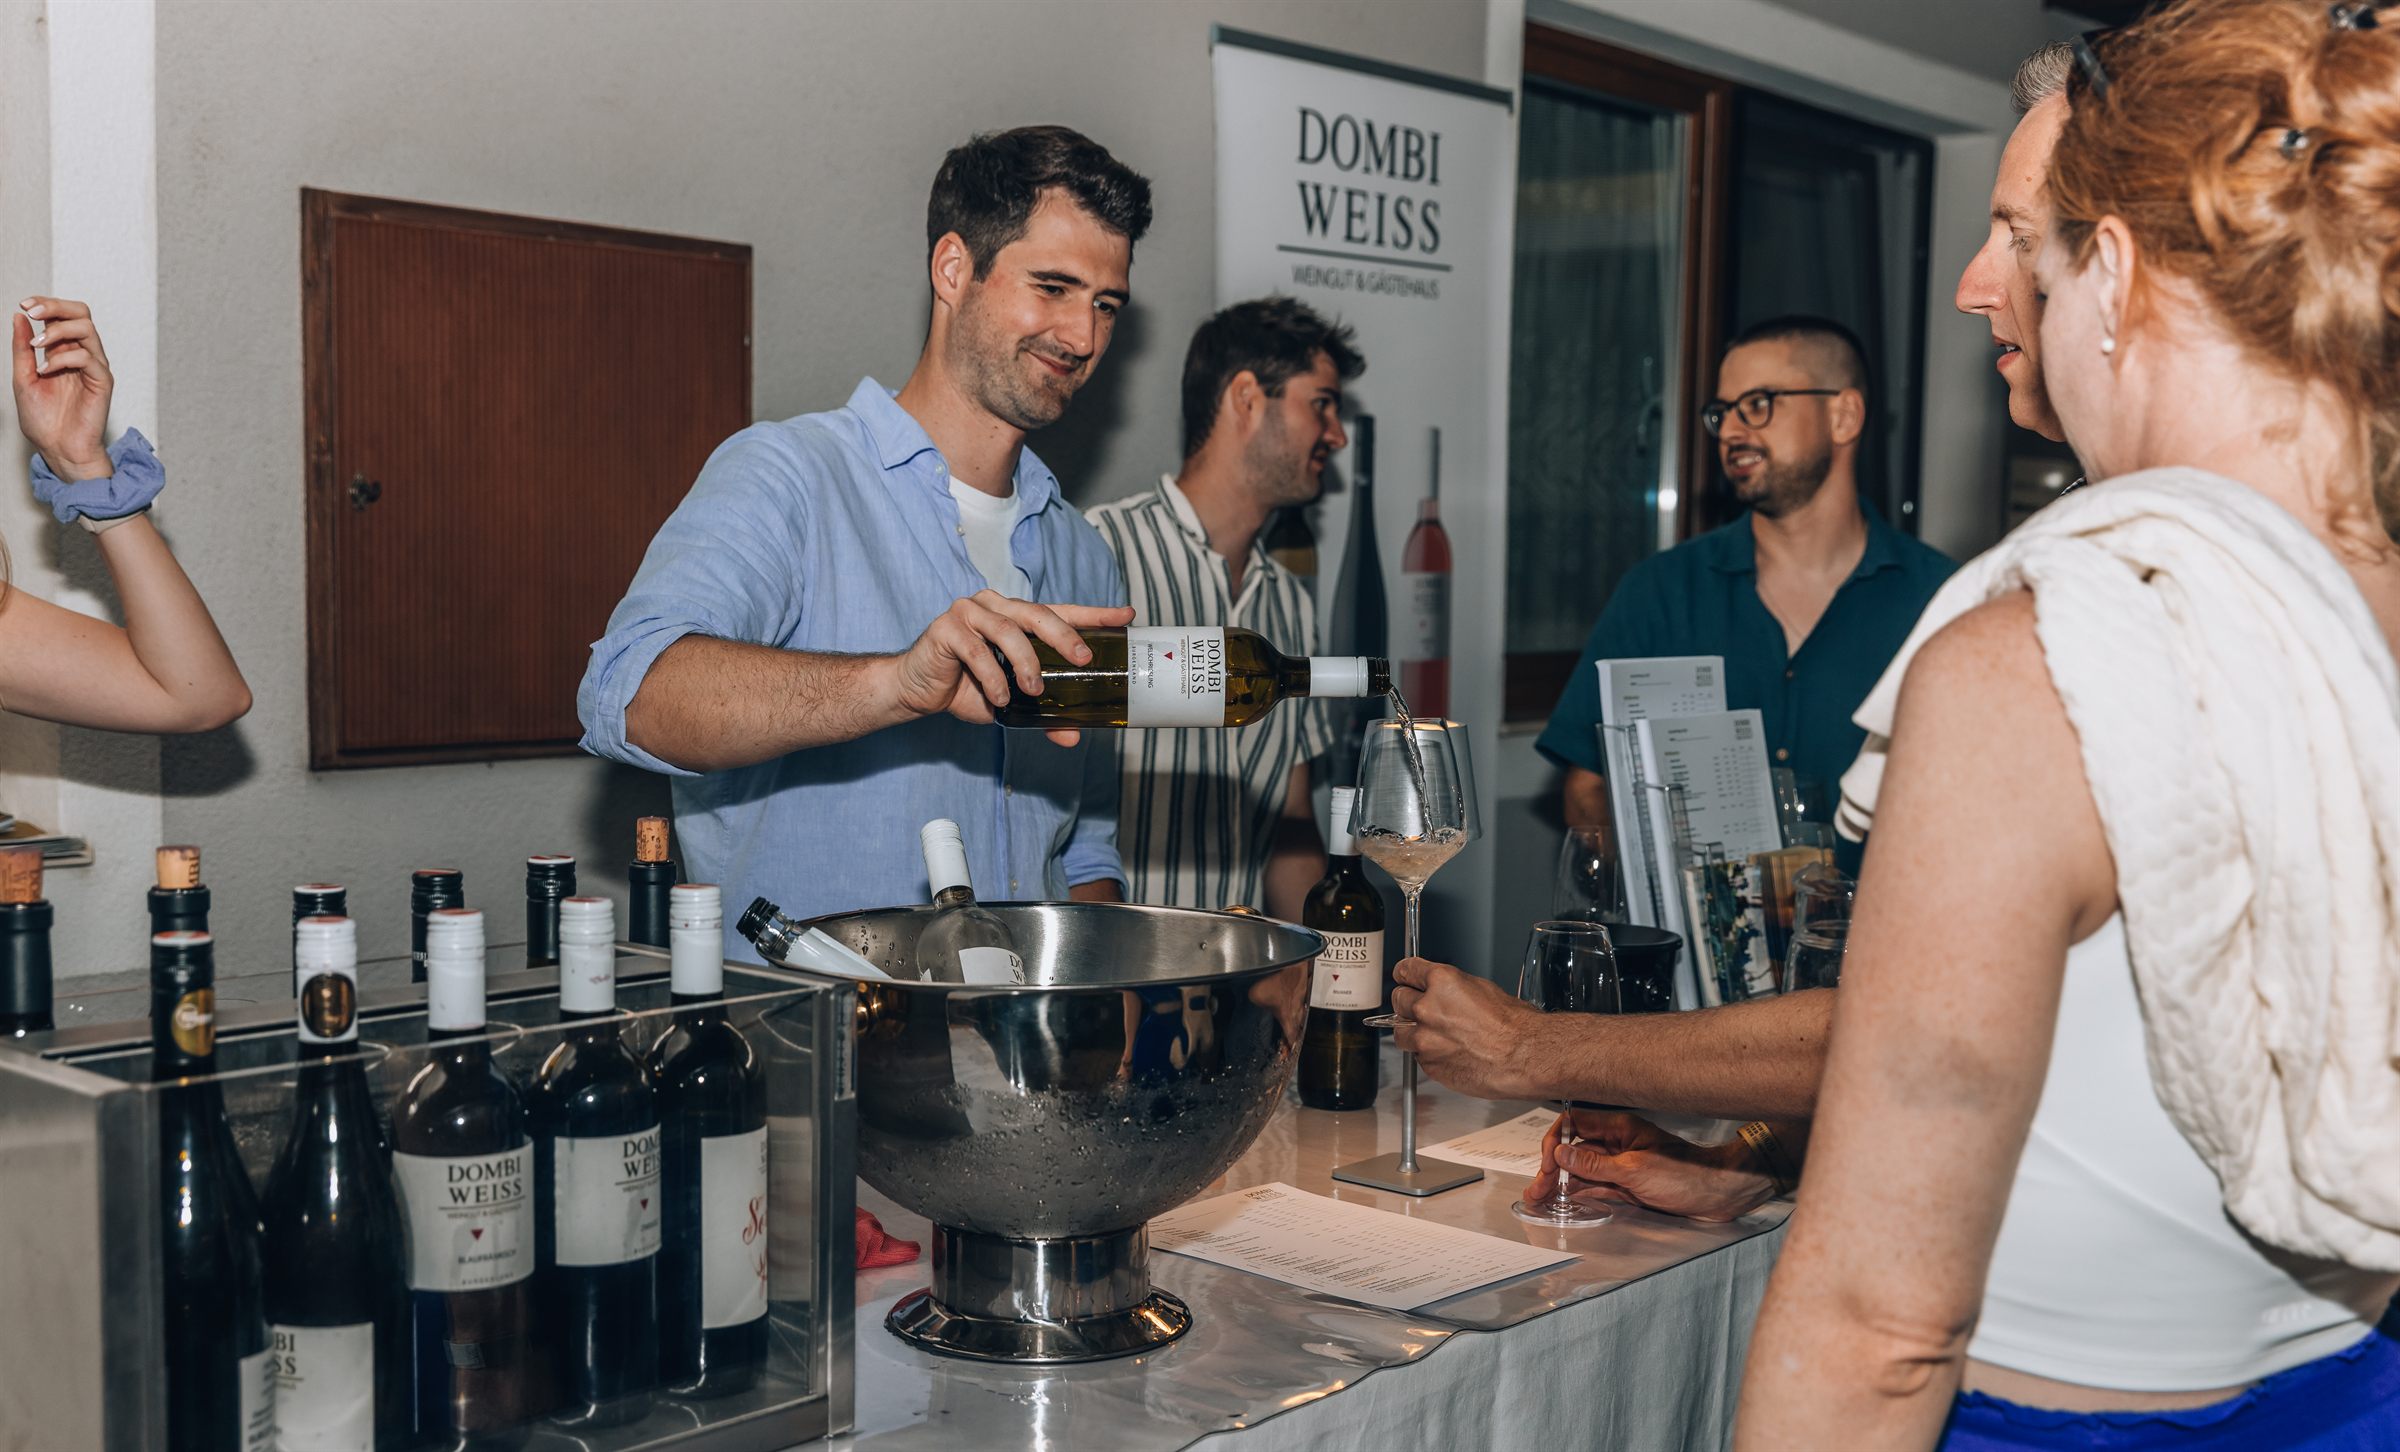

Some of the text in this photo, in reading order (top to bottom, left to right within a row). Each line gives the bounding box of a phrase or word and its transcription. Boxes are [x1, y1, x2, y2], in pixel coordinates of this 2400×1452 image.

[1297, 106, 1441, 186] DOMBI
[1297, 180, 1441, 254] WEISS
[1292, 264, 1353, 291] WEINGUT
[1356, 270, 1364, 292] &
[1191, 640, 1205, 694] WEISS
[1206, 639, 1221, 693] DOMBI
[1322, 949, 1367, 961] WEISS
[448, 1156, 520, 1183] DOMBI
[449, 1178, 522, 1204] WEISS
